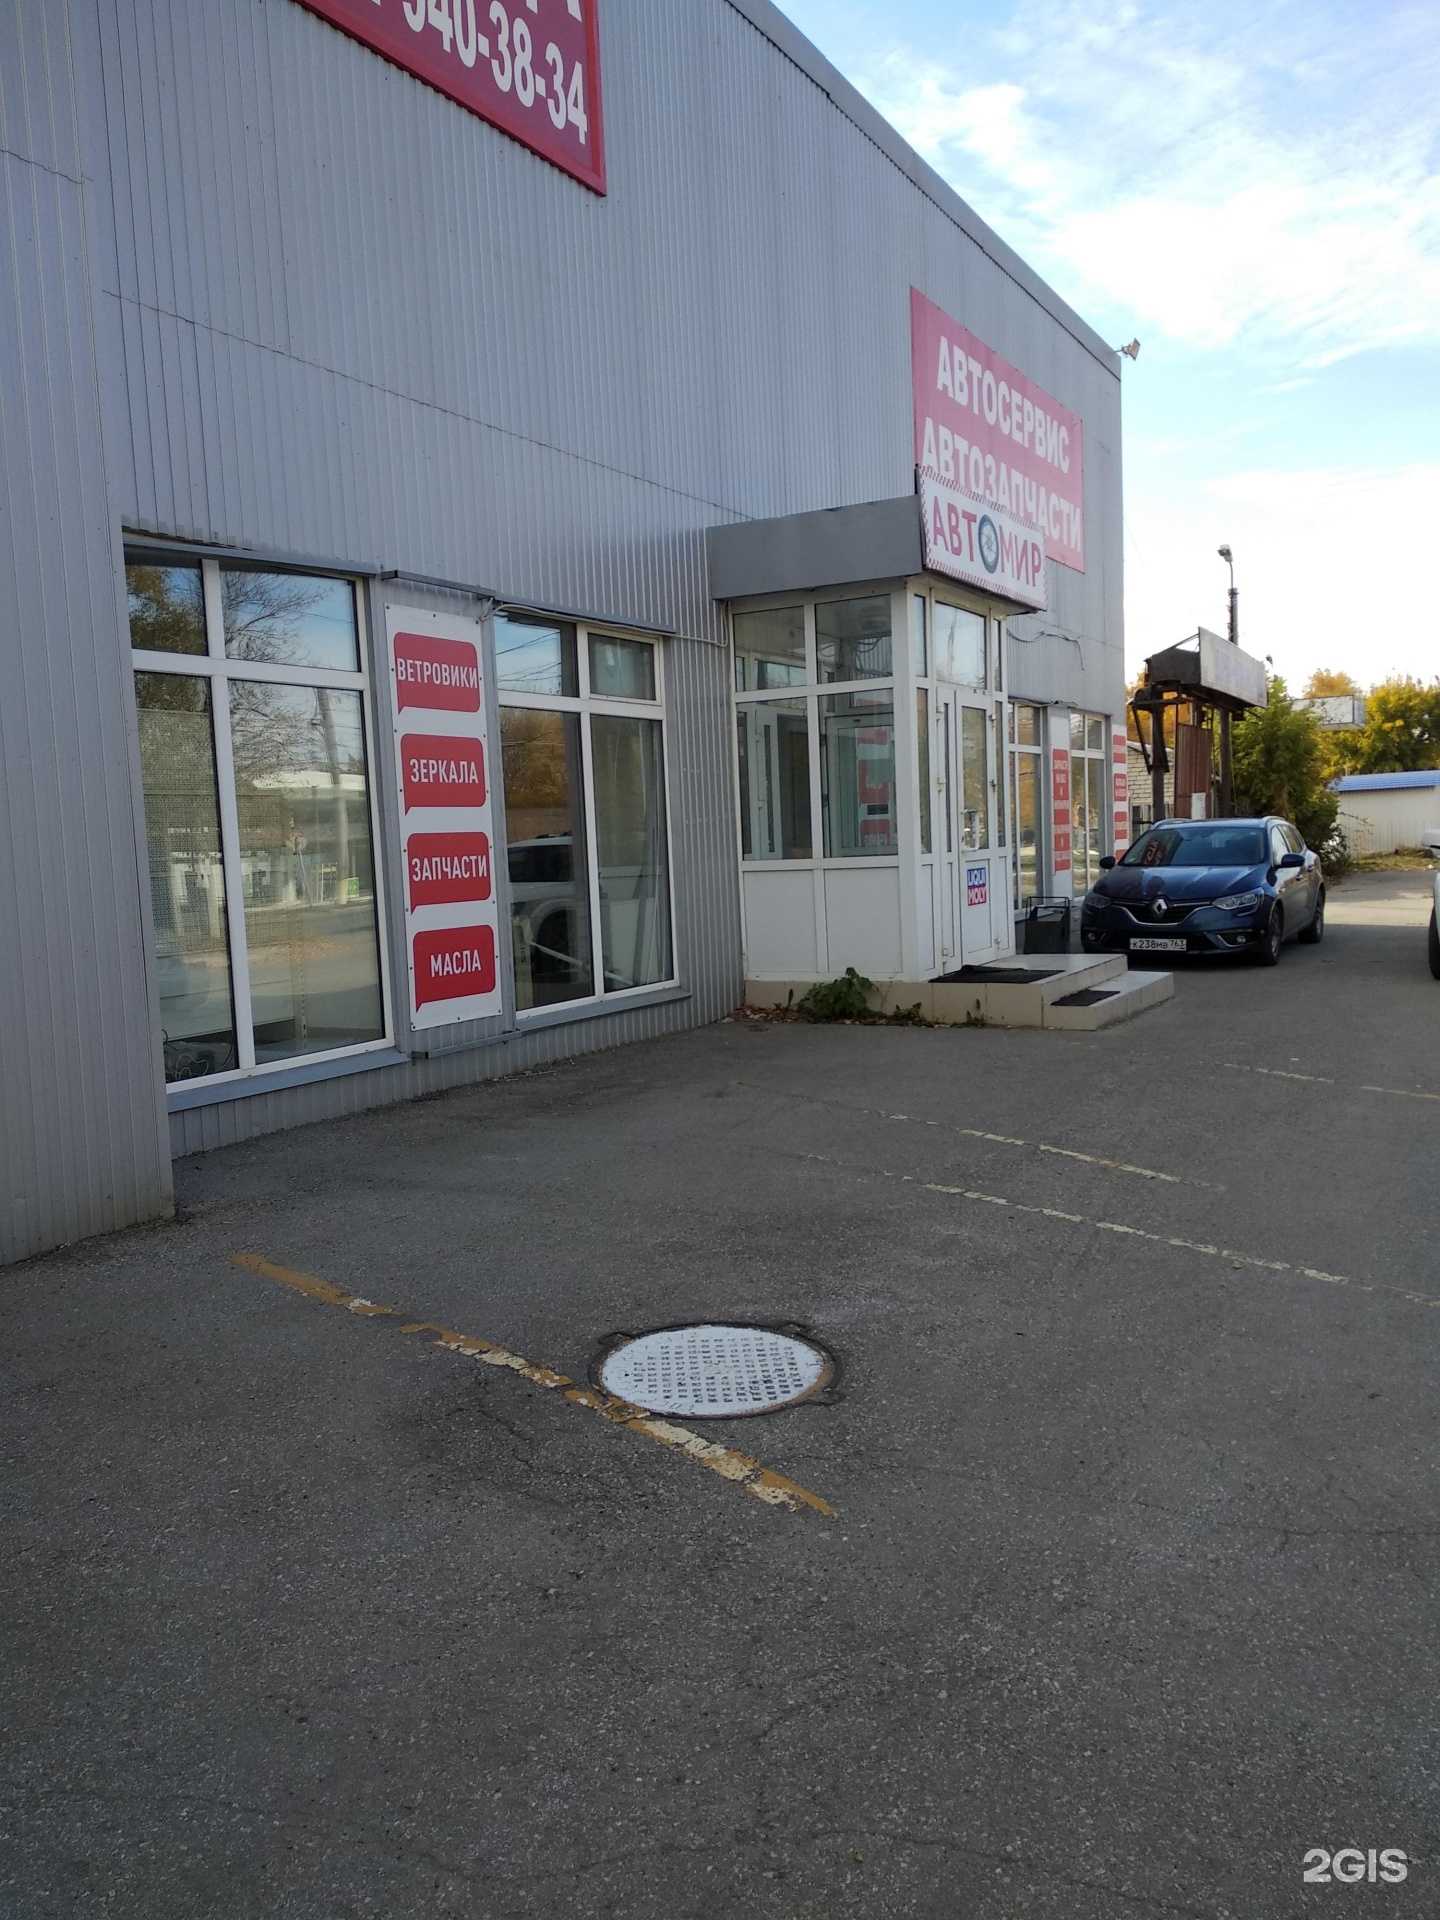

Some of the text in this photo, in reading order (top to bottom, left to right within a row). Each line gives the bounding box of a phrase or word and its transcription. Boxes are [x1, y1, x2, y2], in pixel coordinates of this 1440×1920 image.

[937, 335, 1069, 474] АВТОСЕРВИС
[921, 416, 1082, 552] АВТОЗАПЧАСТИ
[397, 656, 479, 689] ВЕТРОВИКИ
[409, 758, 479, 785] ЗЕРКАЛА
[411, 855, 487, 882] ЗАПЧАСТИ
[430, 953, 481, 978] МАСЛА
